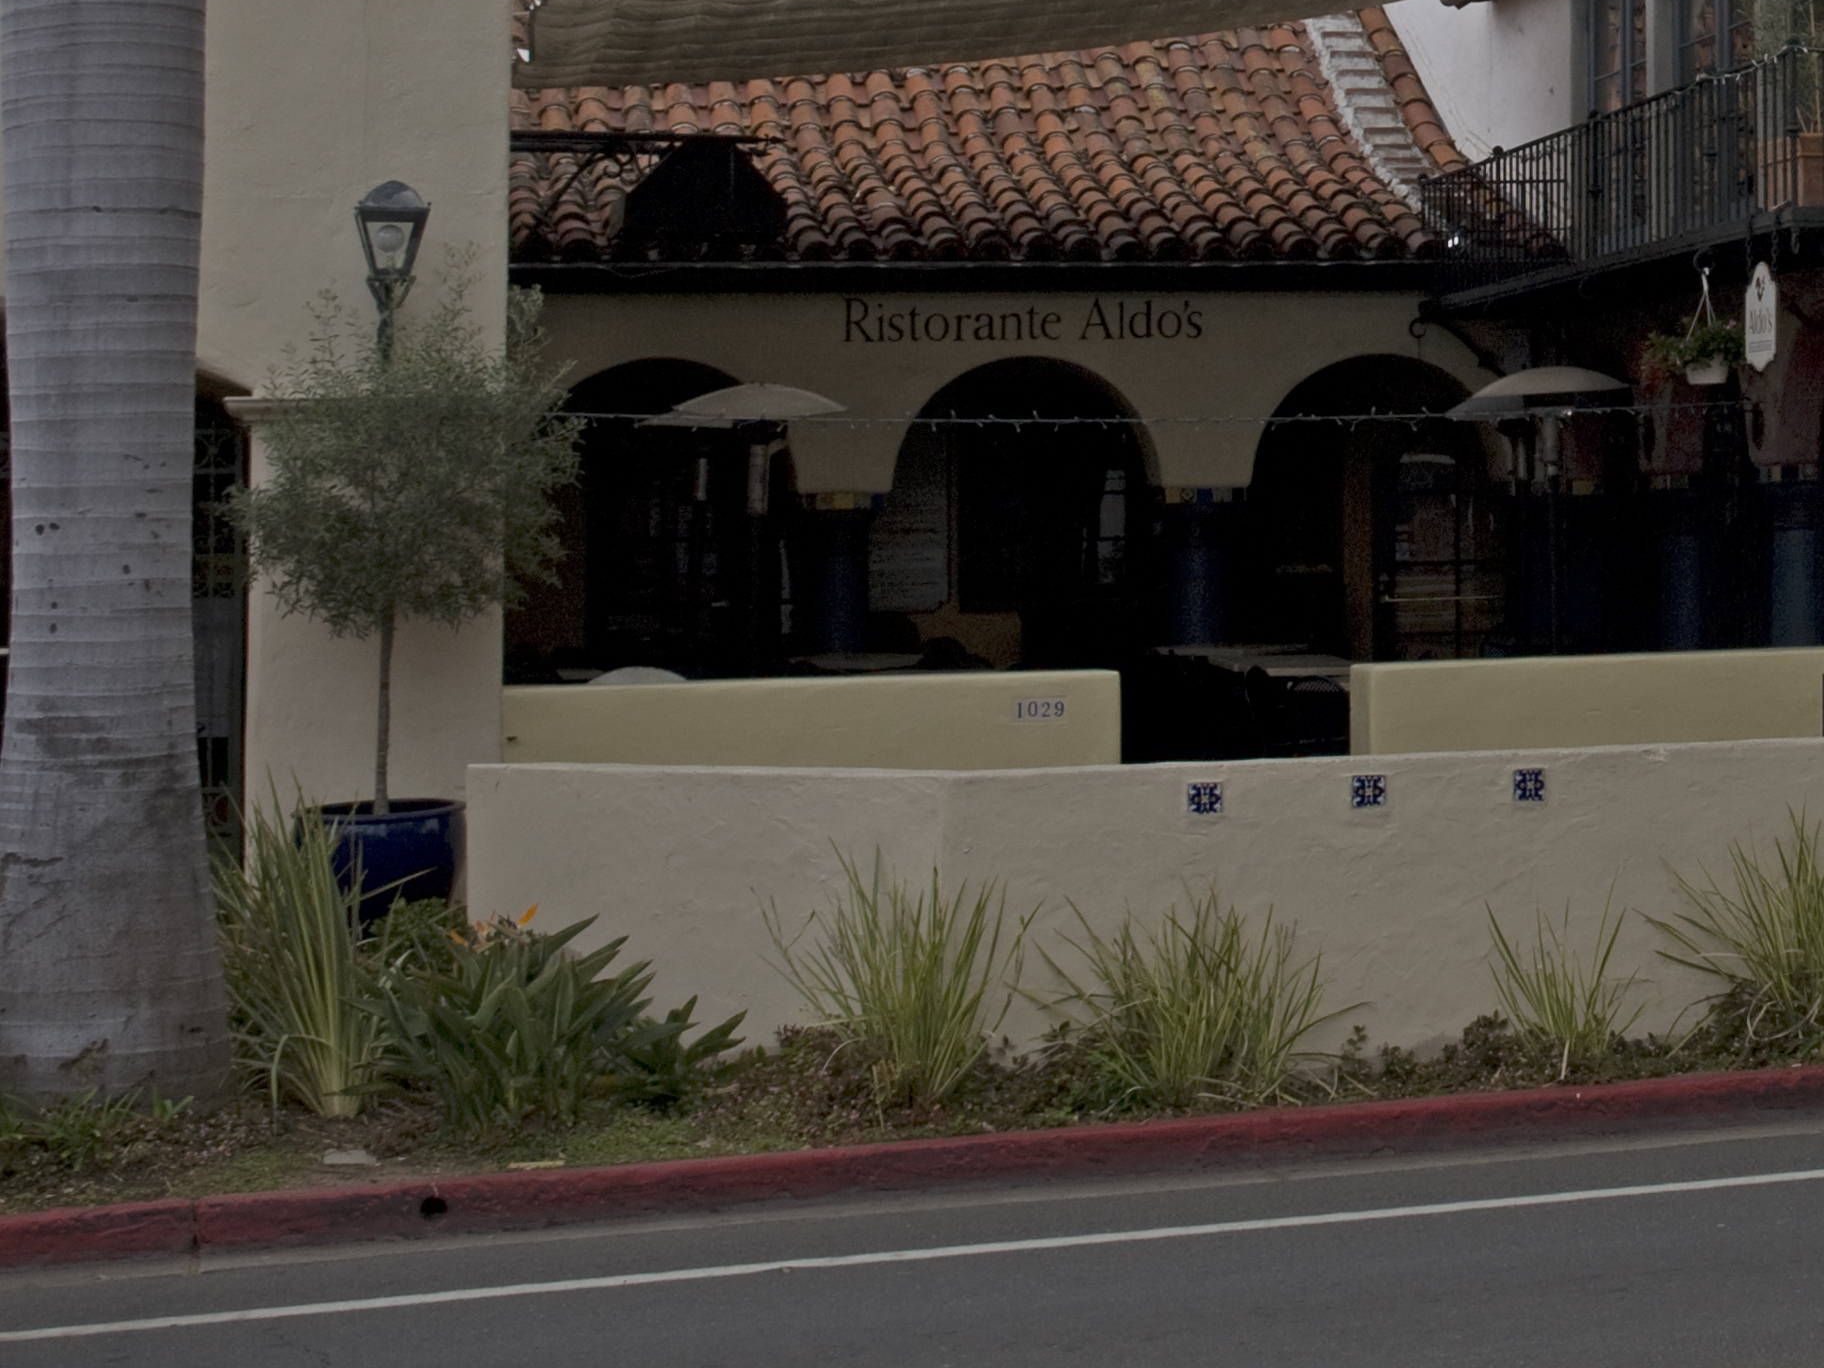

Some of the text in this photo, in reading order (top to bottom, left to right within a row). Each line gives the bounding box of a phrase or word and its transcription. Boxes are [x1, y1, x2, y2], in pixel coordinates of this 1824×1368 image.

[843, 297, 1204, 342] Ristorante Aldo's
[1017, 701, 1065, 719] 1029
